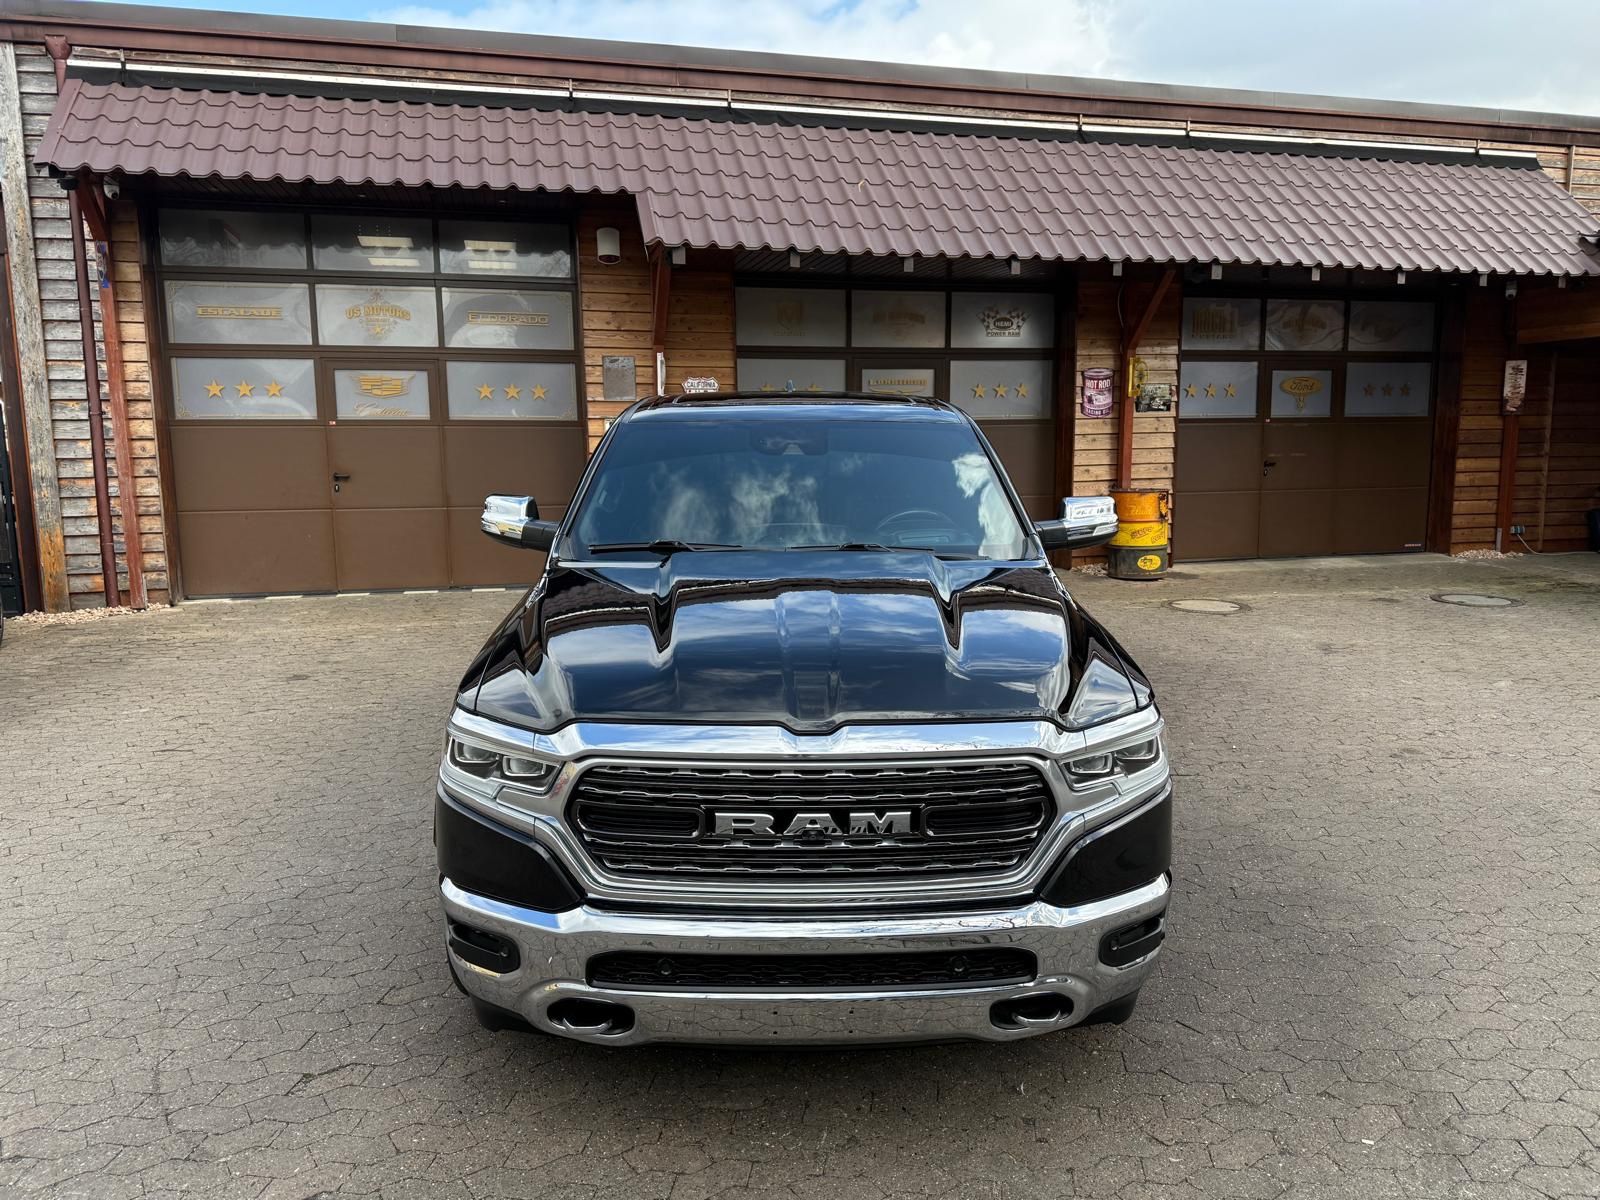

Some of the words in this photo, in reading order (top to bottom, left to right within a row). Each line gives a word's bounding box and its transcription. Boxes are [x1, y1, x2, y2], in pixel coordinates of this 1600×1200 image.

[196, 306, 282, 317] ESCALADE
[345, 305, 361, 320] US
[364, 304, 411, 320] MOTORS
[468, 312, 550, 324] ELDORADO
[1085, 379, 1098, 389] HOT
[1098, 378, 1111, 389] ROD
[1290, 380, 1315, 391] Ford
[715, 812, 911, 835] RAM
